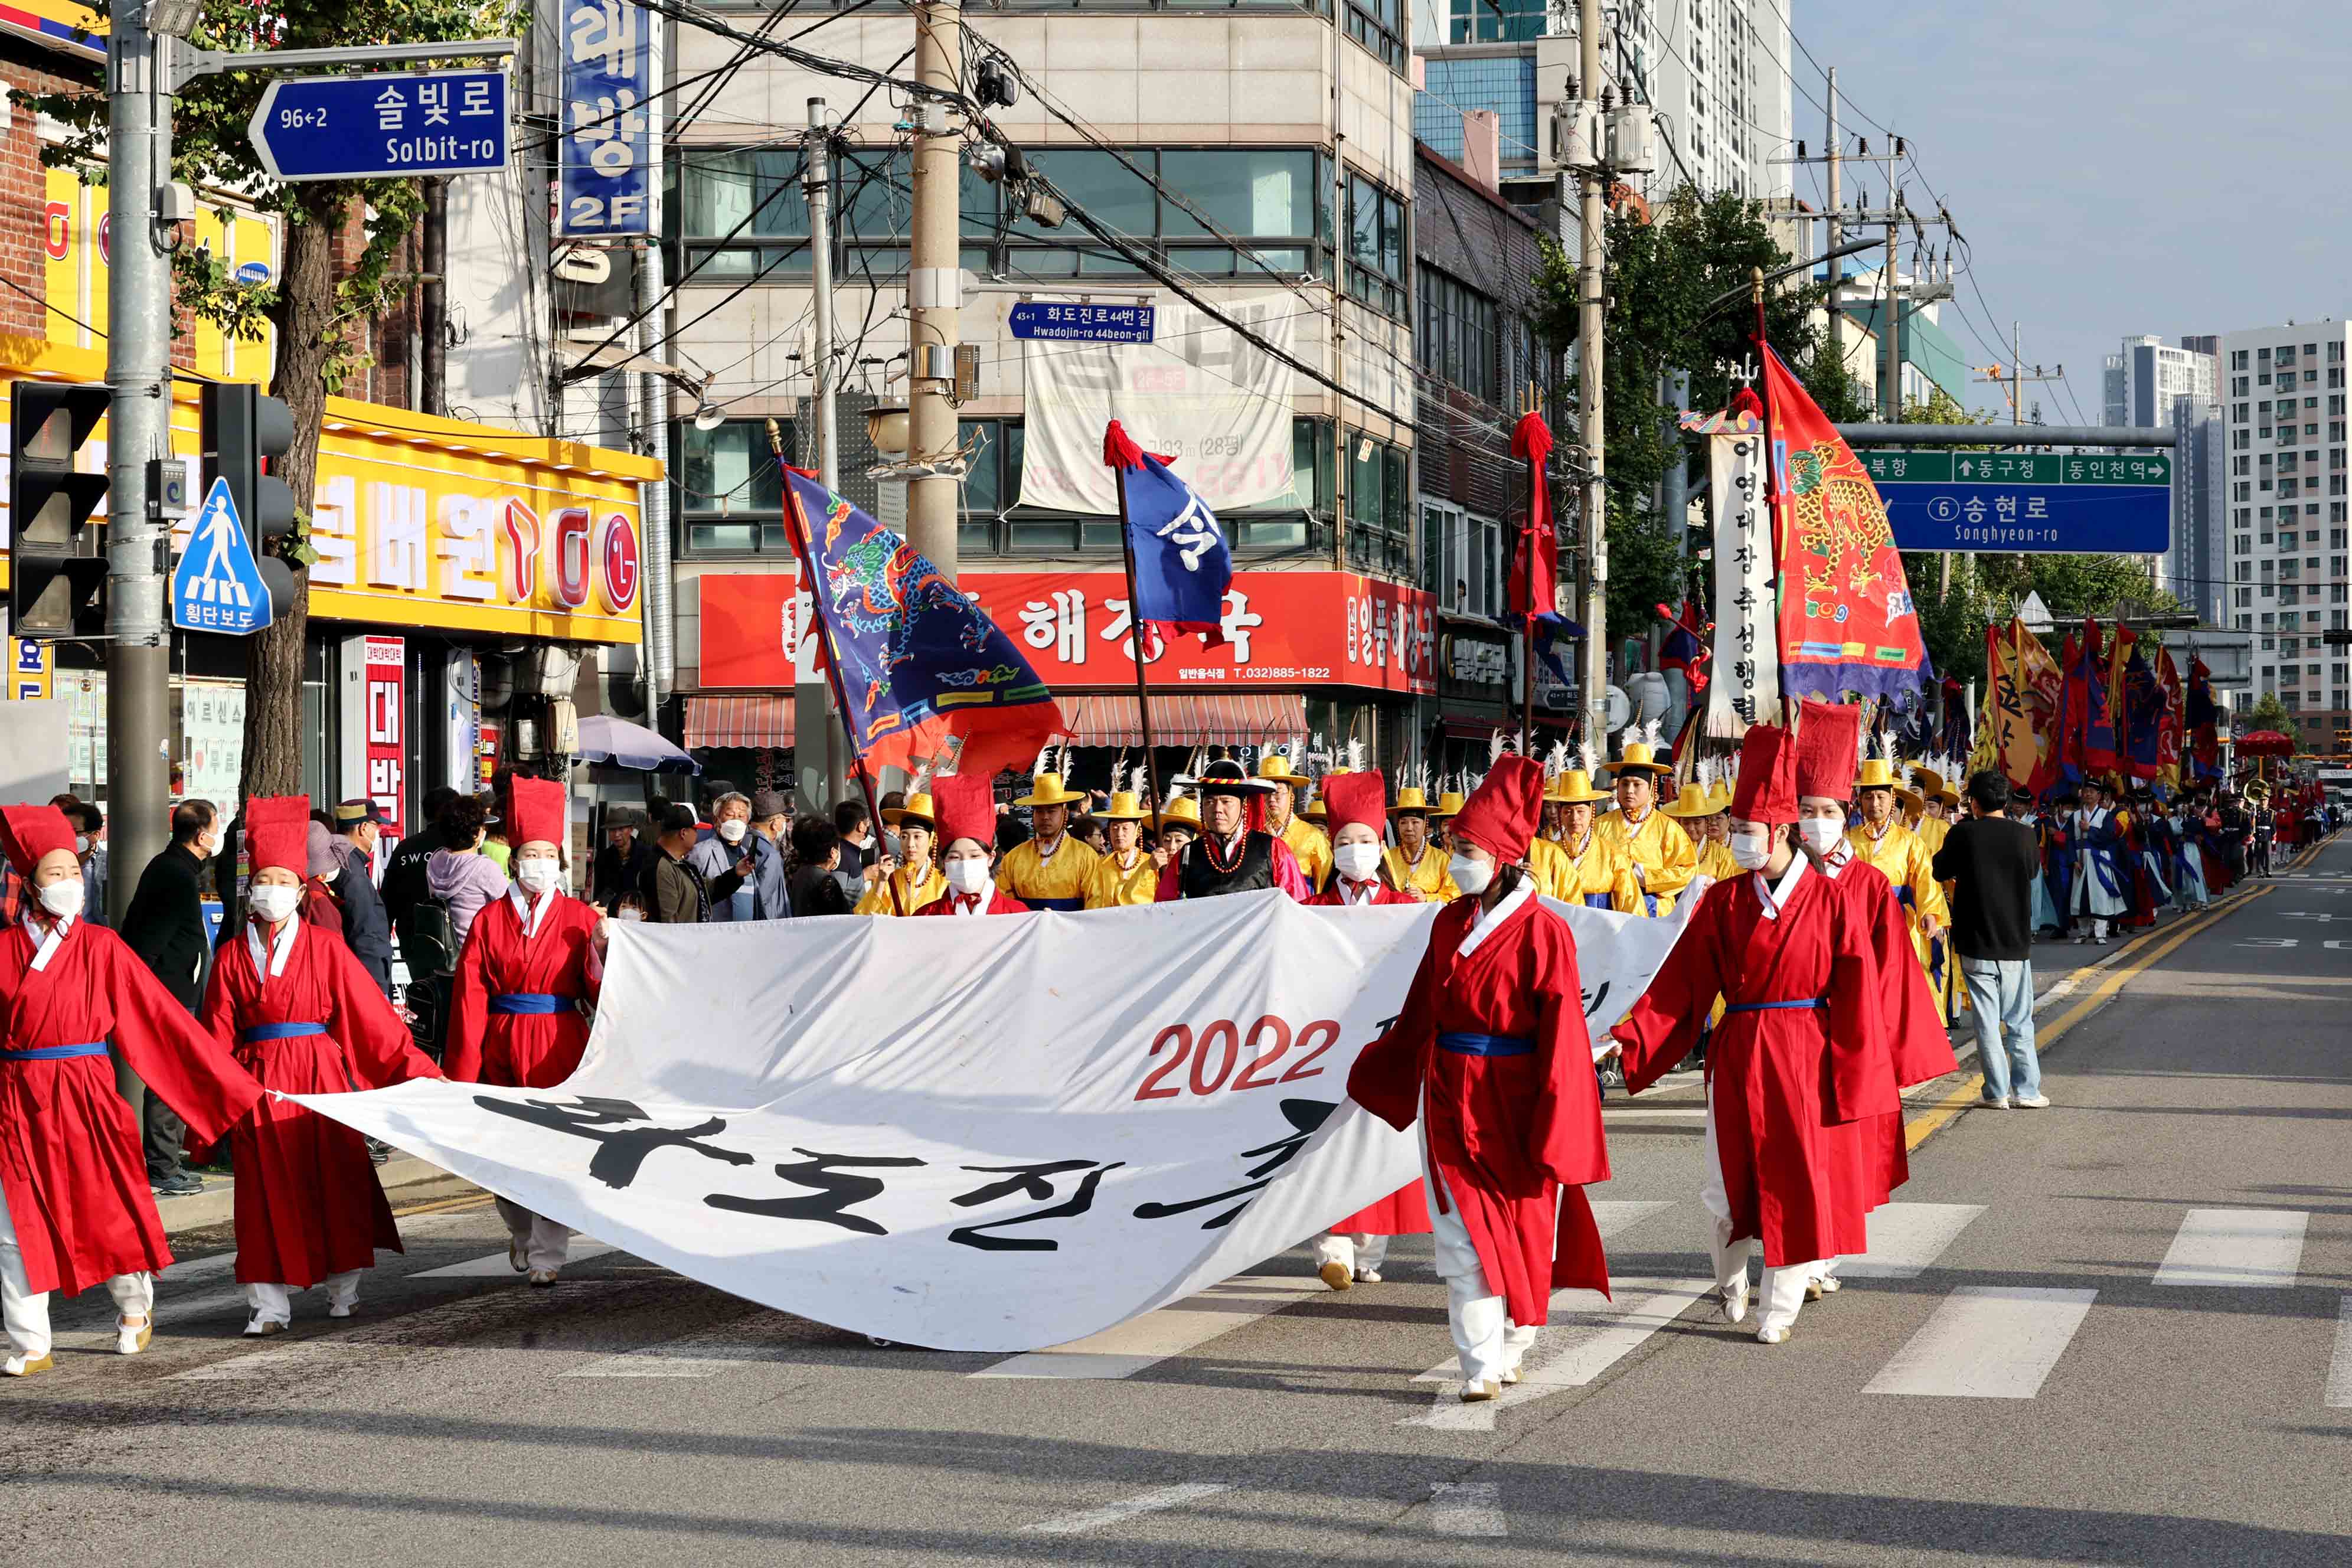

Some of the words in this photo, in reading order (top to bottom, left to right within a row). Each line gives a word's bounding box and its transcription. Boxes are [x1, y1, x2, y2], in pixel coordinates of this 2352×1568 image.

[374, 81, 494, 130] 솔빛로
[387, 136, 494, 164] Solbit-ro
[569, 195, 644, 227] 2F
[239, 267, 266, 282] SAMSUNG
[1047, 306, 1109, 325] 화도진로
[1110, 309, 1151, 327] 44번길
[1034, 326, 1093, 339] Hwadojin-ro
[1096, 329, 1149, 341] 44beon-gil
[1870, 458, 1907, 476] 북항
[1978, 460, 2034, 479] 동구청
[2068, 460, 2145, 480] 동인천역
[1964, 495, 2050, 523] 송현로
[1955, 524, 2058, 544] Songhyeon-ro
[185, 603, 256, 628] 횡단보도
[1360, 594, 1435, 677] 일품해장국
[1178, 668, 1225, 680] 일반음식점
[1233, 667, 1331, 679] T.032)885-1822
[1133, 1014, 1341, 1101] 2022
